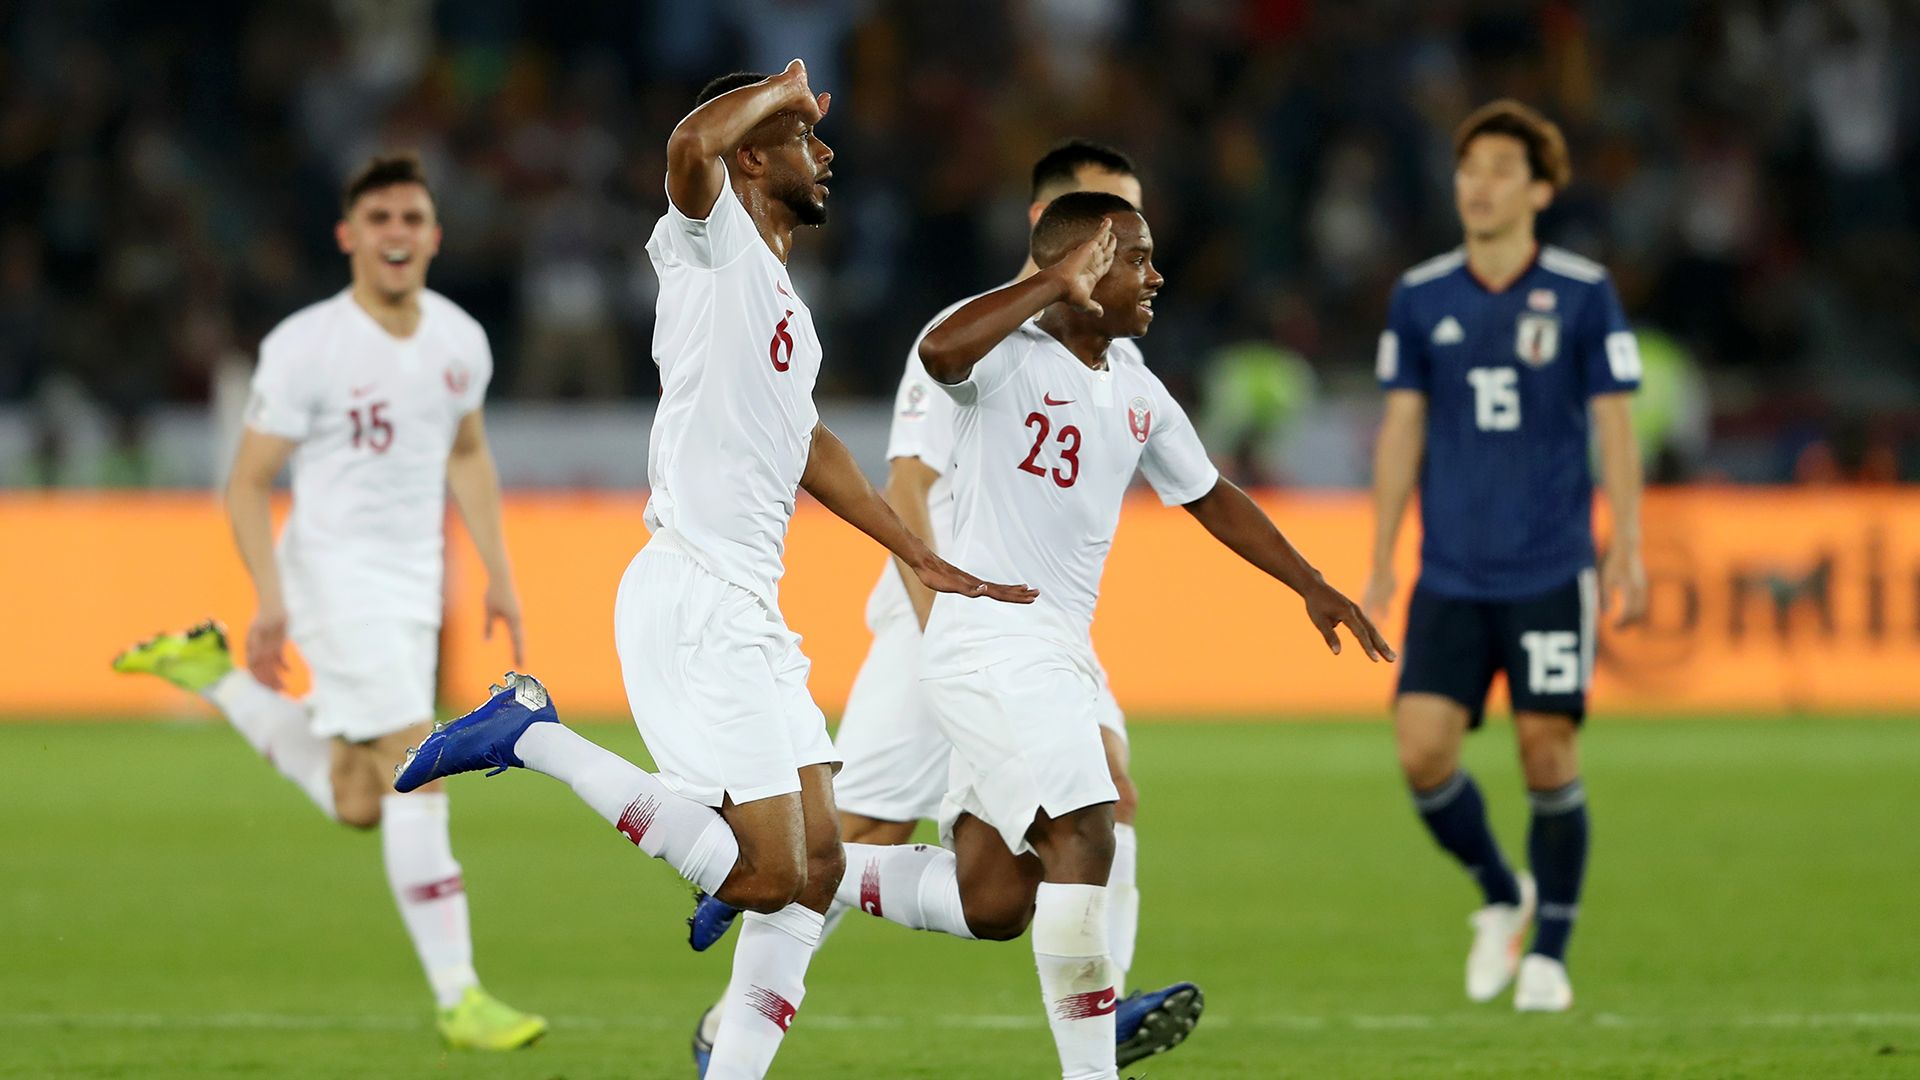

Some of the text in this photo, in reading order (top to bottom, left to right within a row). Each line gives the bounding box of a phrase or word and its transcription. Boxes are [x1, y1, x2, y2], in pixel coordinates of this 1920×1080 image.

[770, 309, 794, 373] 6
[347, 401, 395, 454] 15
[1467, 366, 1521, 432] 15
[1017, 411, 1082, 489] 23
[1520, 631, 1579, 694] 15
